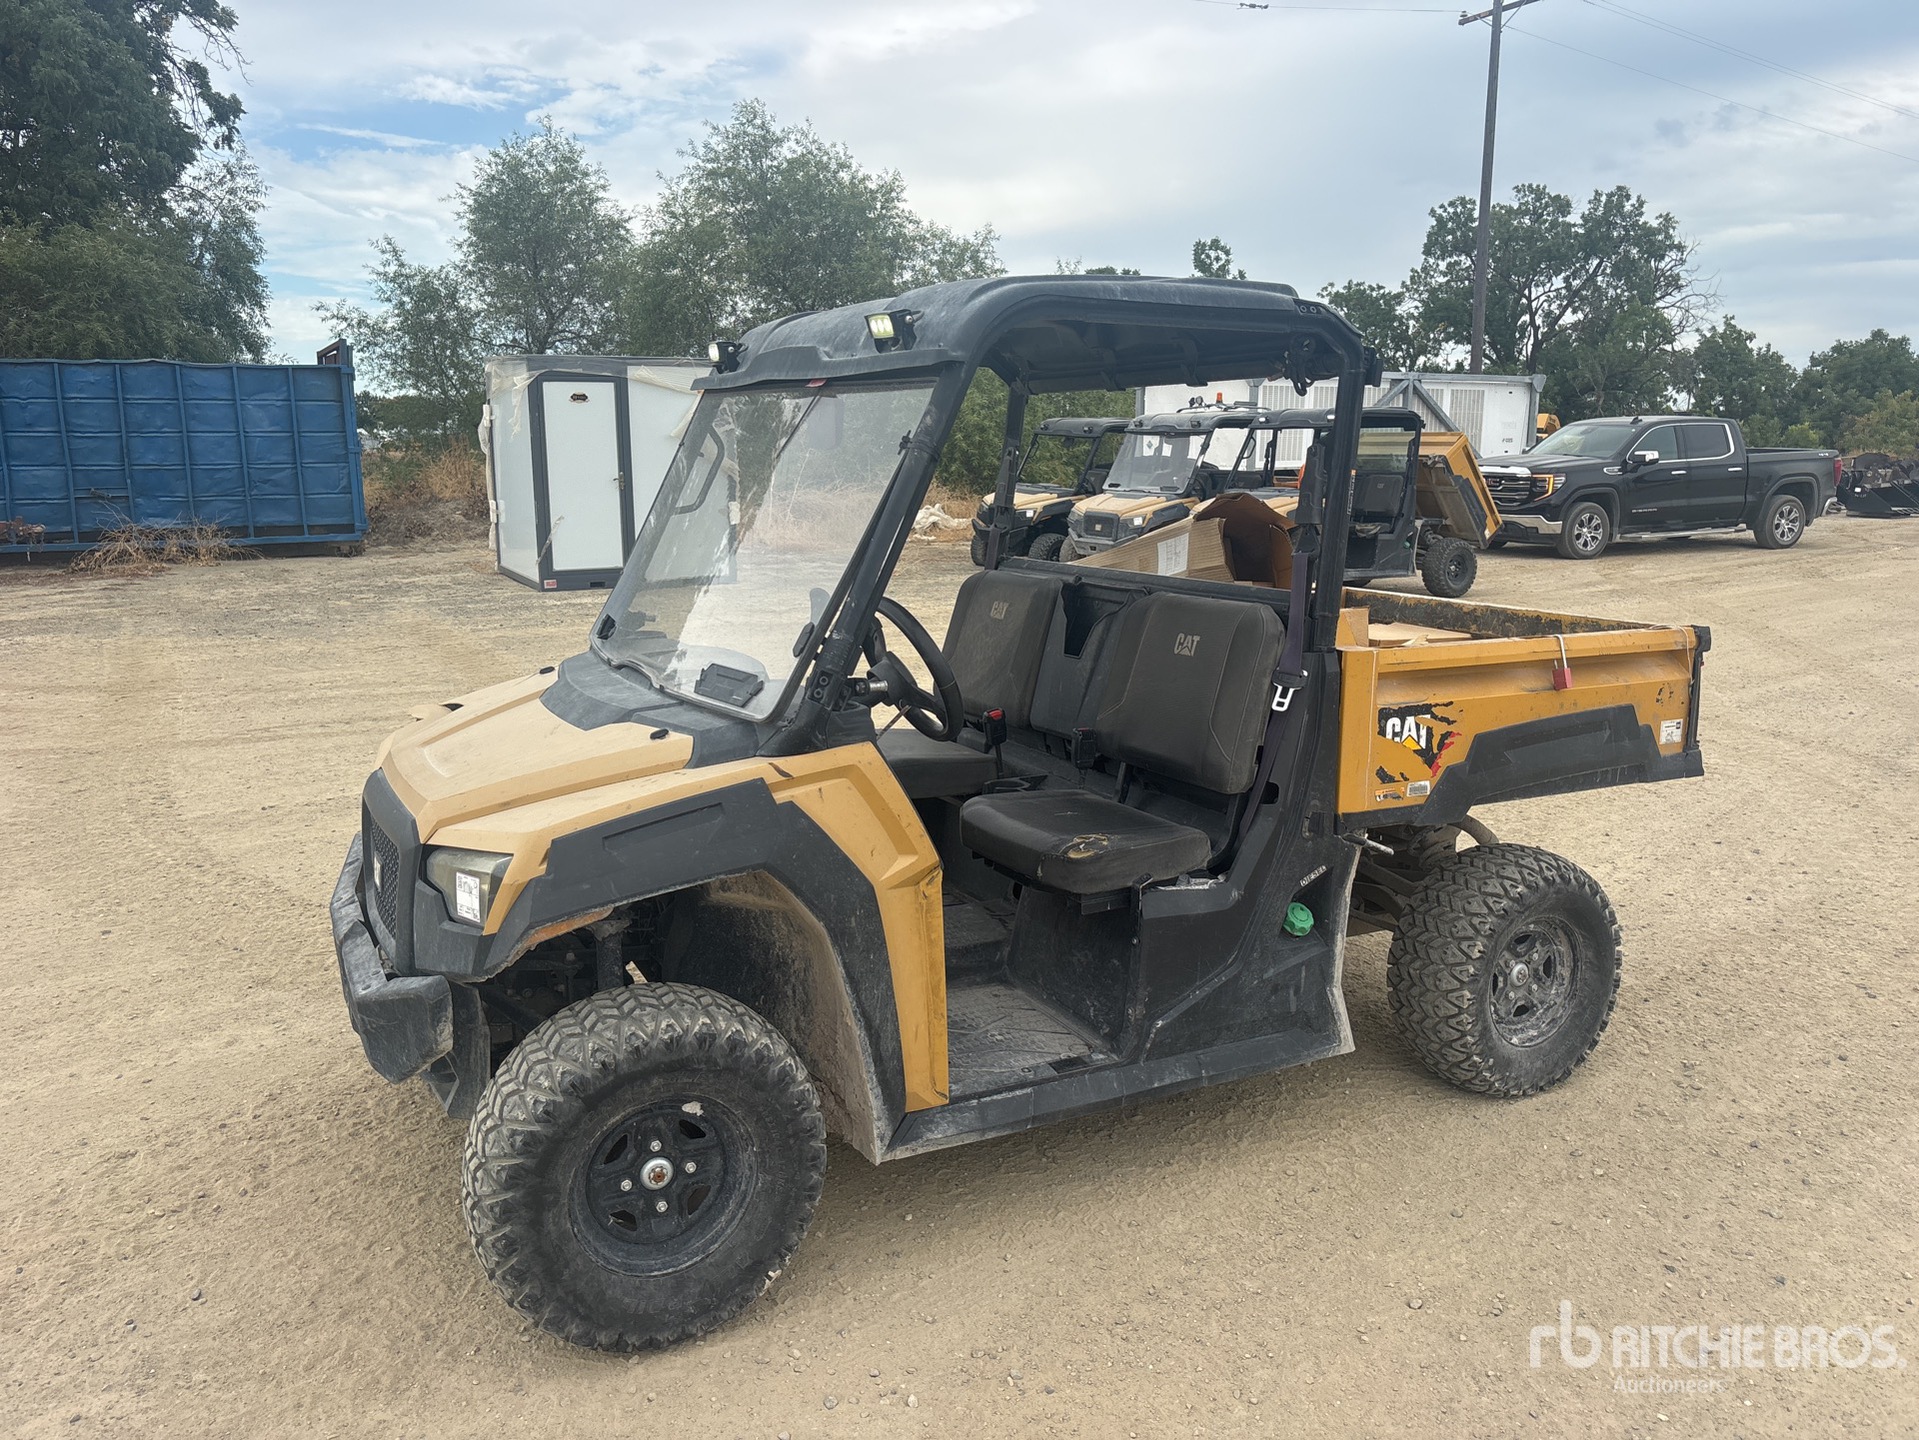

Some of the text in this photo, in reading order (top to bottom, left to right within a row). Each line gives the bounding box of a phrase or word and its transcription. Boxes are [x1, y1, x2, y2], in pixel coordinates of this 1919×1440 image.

[990, 600, 1010, 620] CAT
[1174, 632, 1201, 657] CAT
[1385, 714, 1431, 750] CAT
